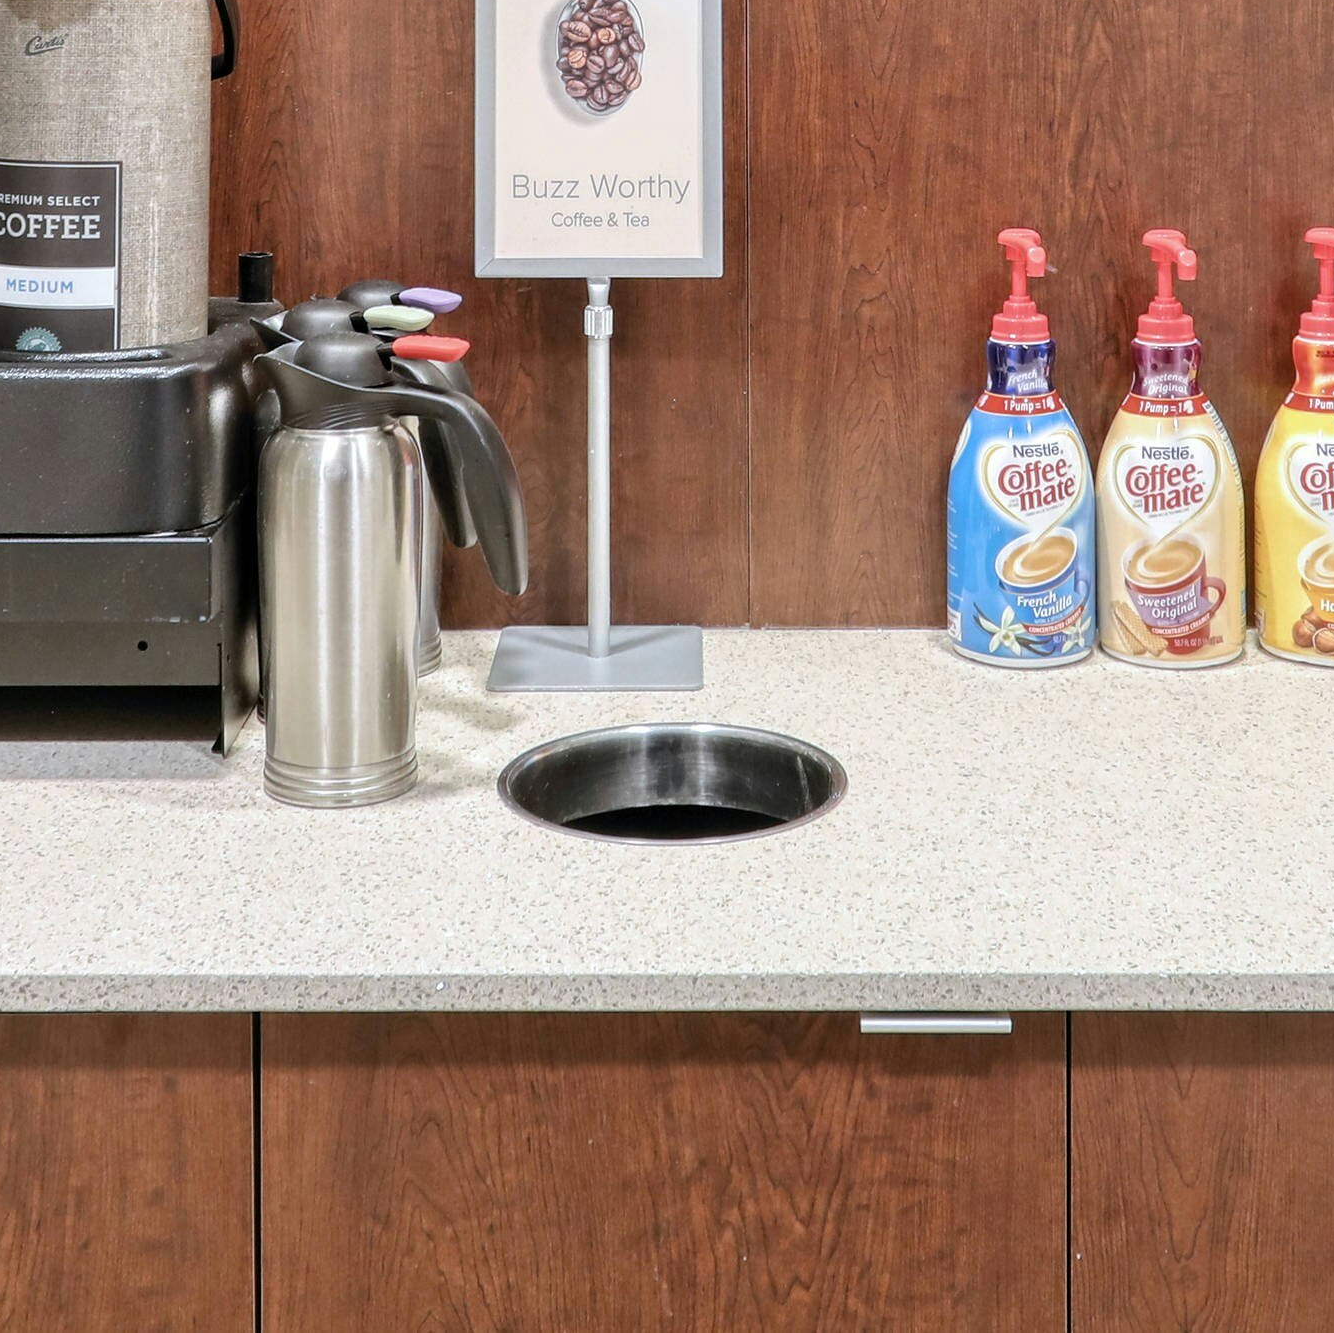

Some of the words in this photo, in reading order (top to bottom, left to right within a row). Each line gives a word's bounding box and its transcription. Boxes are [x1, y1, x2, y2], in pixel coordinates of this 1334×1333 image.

[24, 35, 65, 56] Curtis
[512, 174, 580, 199] Buzz
[590, 173, 691, 205] Worthy
[47, 195, 101, 207] SELECT
[551, 211, 603, 228] Coffee
[607, 212, 619, 228] &
[622, 212, 650, 228] Tea
[6, 278, 74, 294] MEDIUM
[1010, 399, 1034, 413] Pump
[1145, 401, 1169, 416] Pump
[1012, 442, 1059, 458] Nestlé
[1142, 446, 1190, 460] Nestlé
[1019, 477, 1075, 512] mate
[1143, 483, 1204, 513] mate
[1017, 590, 1057, 608] French
[1137, 583, 1196, 607] Sweetened
[1033, 595, 1072, 618] Vanilla
[1151, 597, 1197, 620] Original
